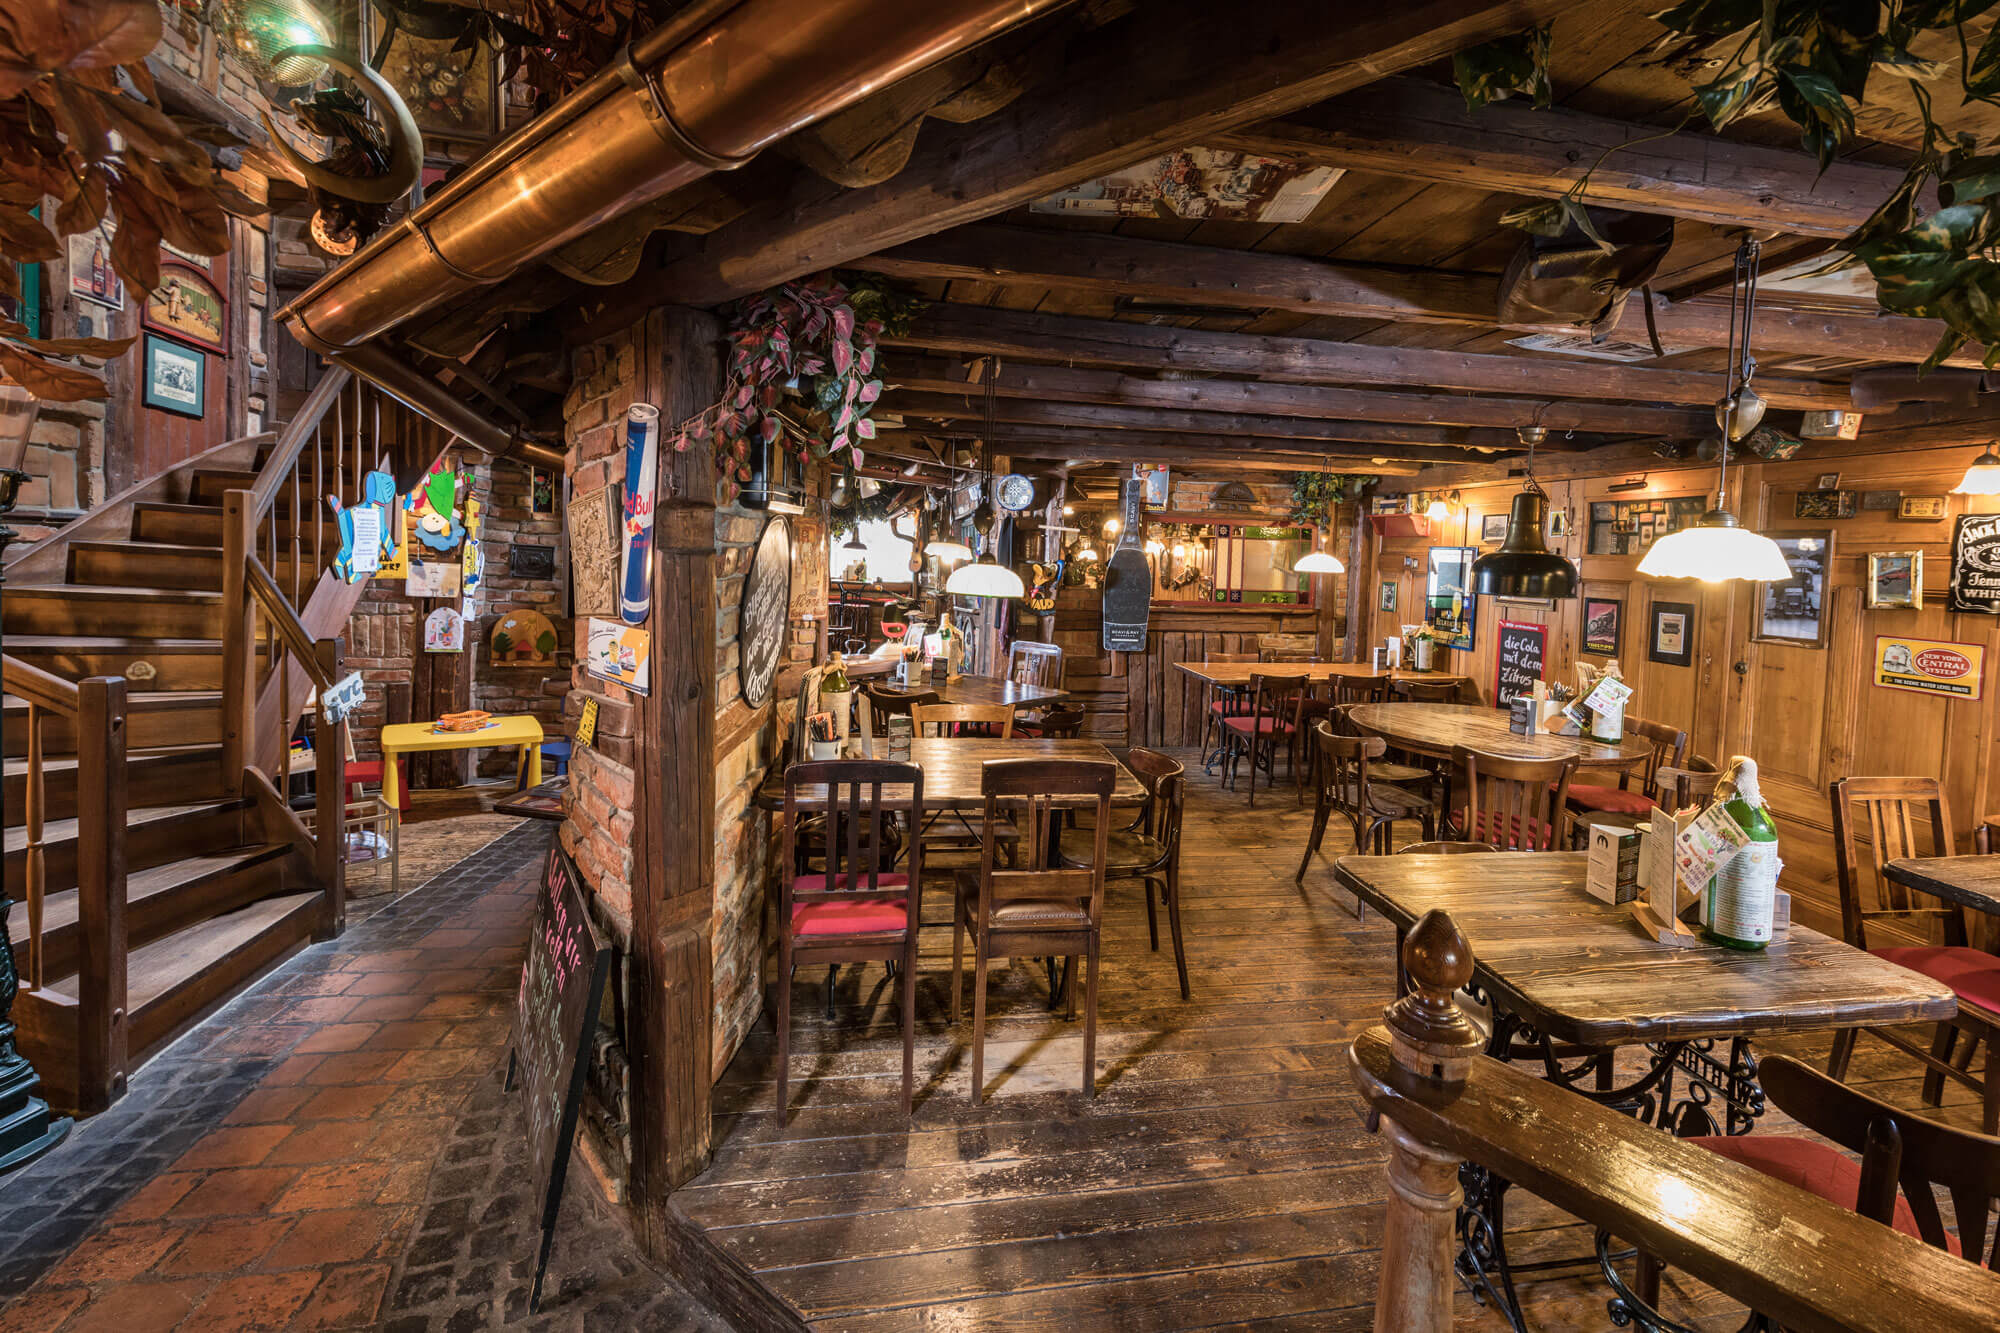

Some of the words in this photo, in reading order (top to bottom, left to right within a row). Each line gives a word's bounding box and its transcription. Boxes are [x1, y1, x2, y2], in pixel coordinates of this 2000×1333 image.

[635, 491, 654, 515] Bull
[1964, 522, 1995, 543] JACK
[1504, 635, 1520, 650] die
[1520, 637, 1540, 654] Cola
[1503, 650, 1519, 664] mit
[1520, 654, 1543, 671] dem
[1917, 657, 1968, 671] CENTRAL
[1923, 652, 1940, 661] NEW
[1942, 654, 1963, 663] YORK
[1501, 666, 1532, 686] Zitrus
[1925, 667, 1957, 676] SYSTEM
[339, 680, 361, 704] WC
